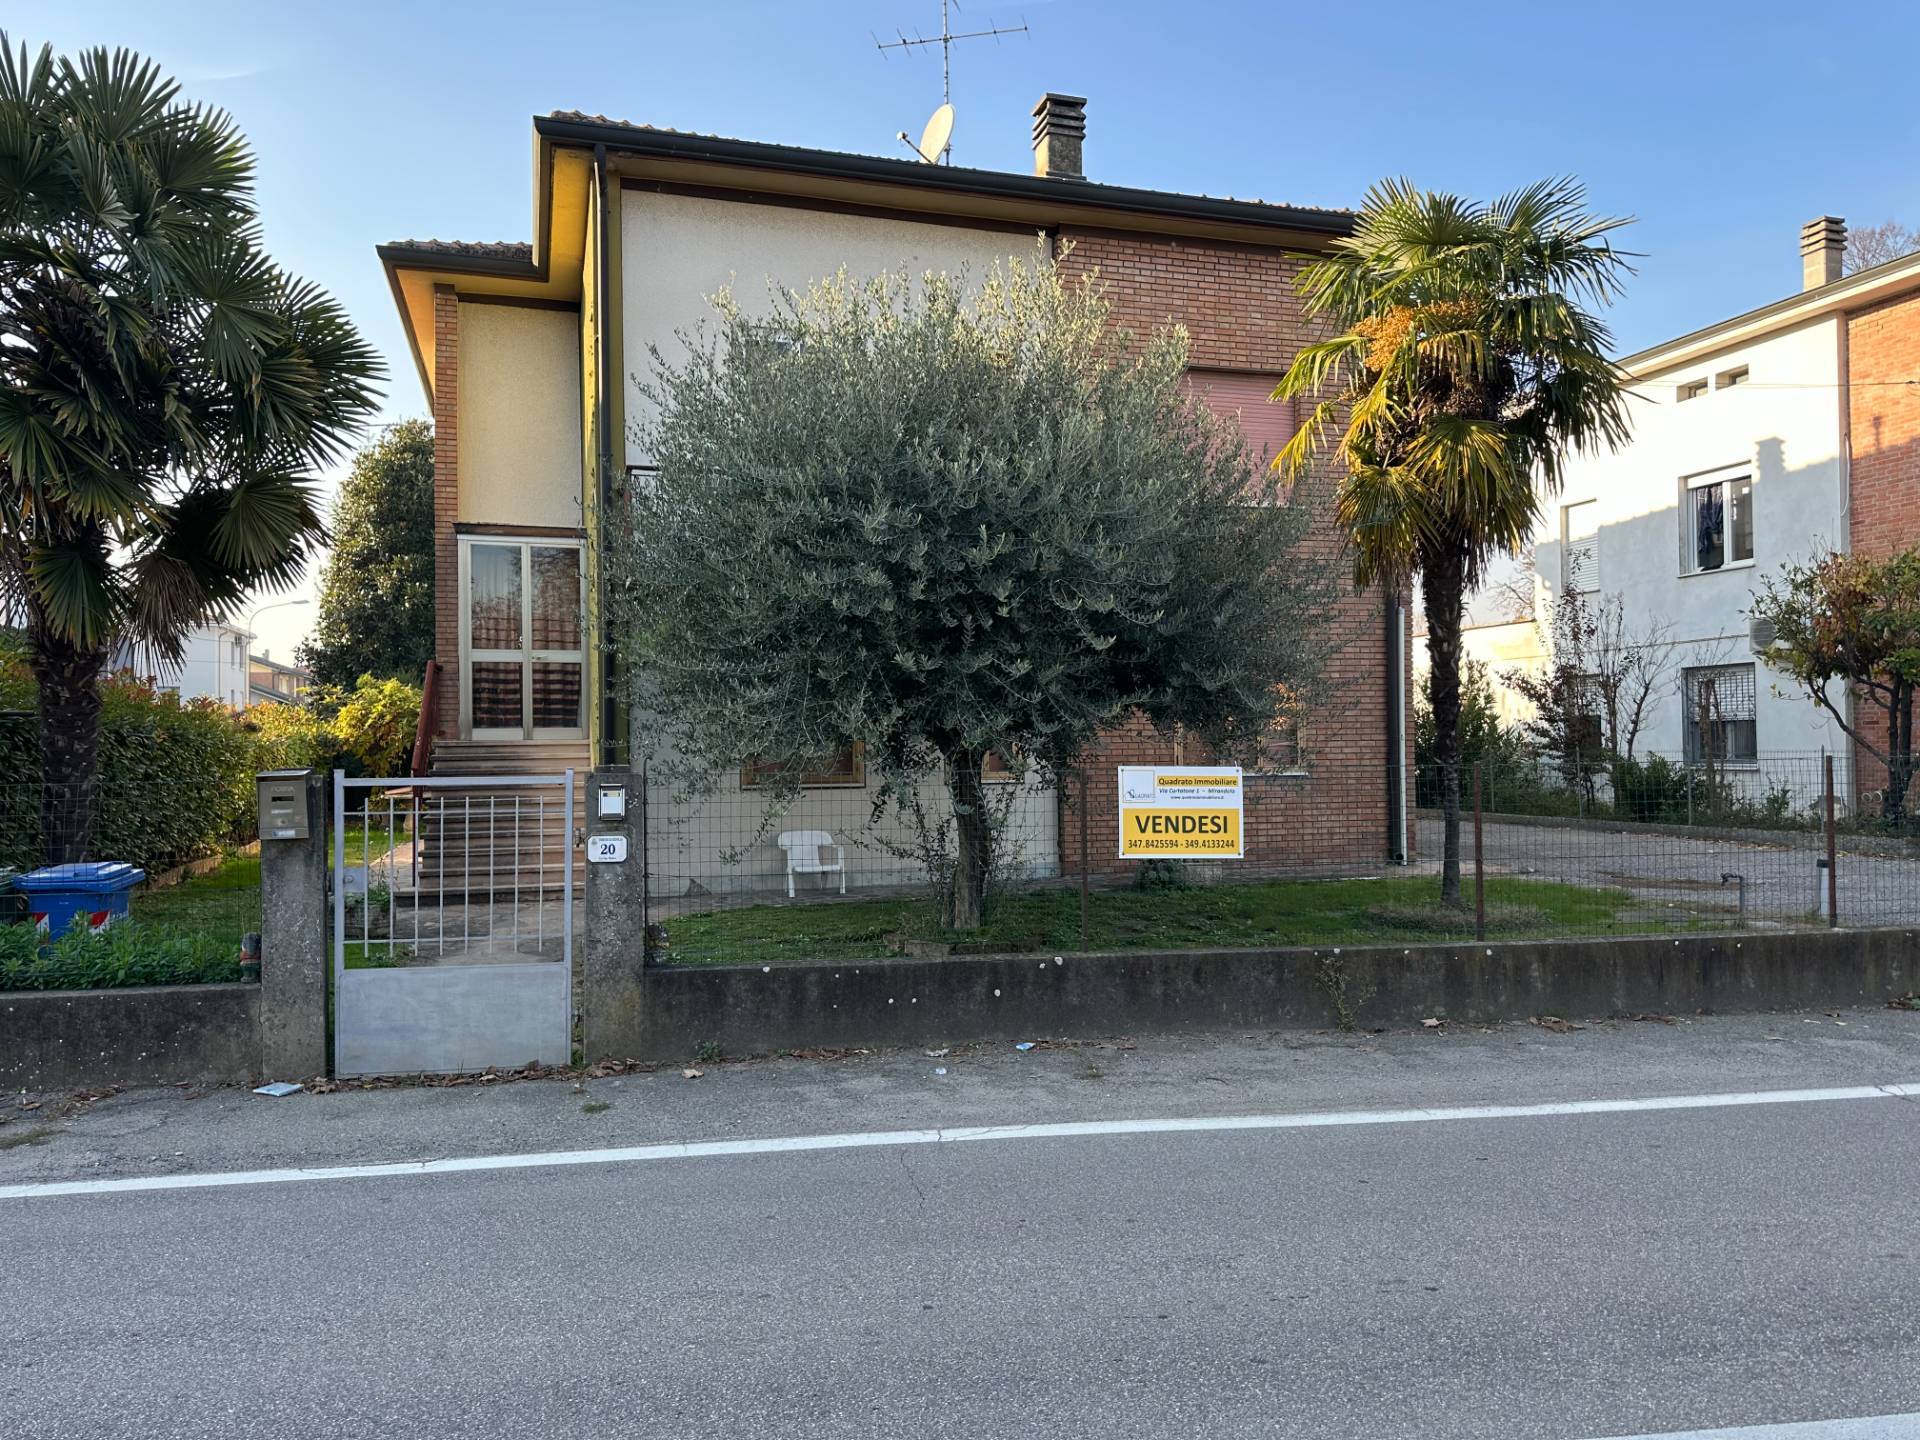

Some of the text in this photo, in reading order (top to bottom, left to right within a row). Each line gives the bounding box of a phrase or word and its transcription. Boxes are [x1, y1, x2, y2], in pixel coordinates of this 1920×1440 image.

[1159, 778, 1192, 786] Quadrato
[1135, 815, 1228, 834] VENDESI
[1128, 839, 1179, 848] 347.8425594
[1185, 839, 1235, 848] 349.4133244
[600, 843, 616, 855] 20
